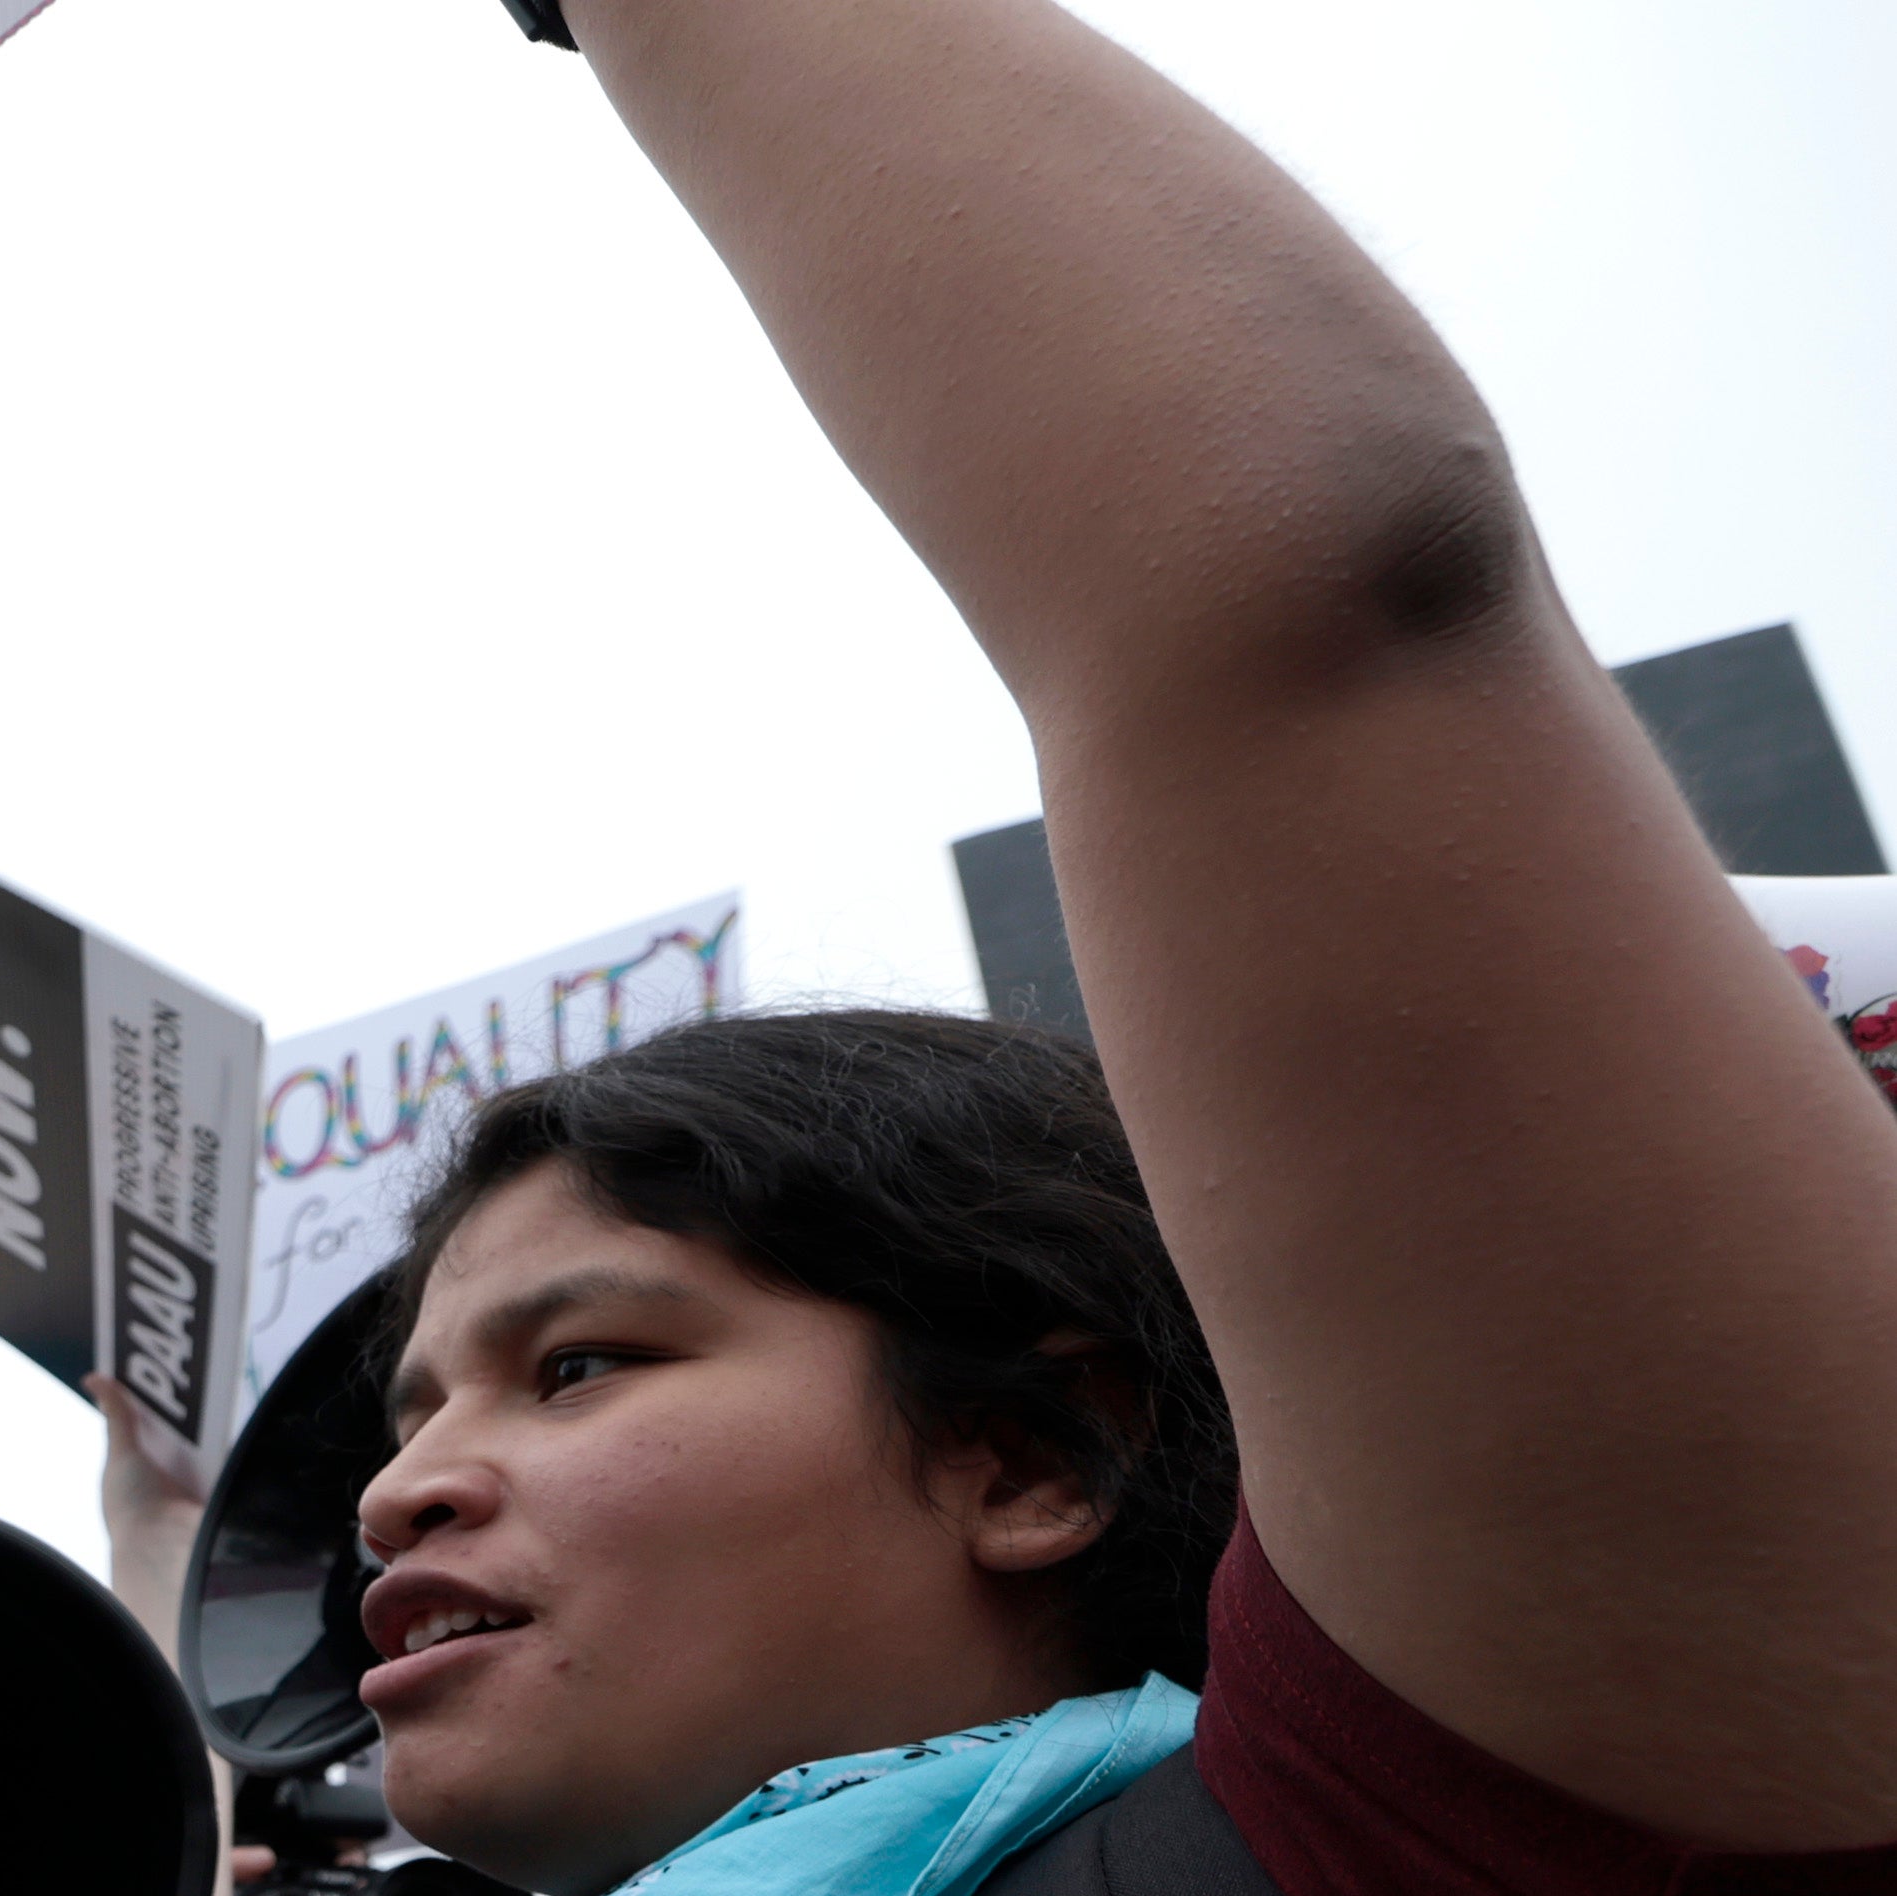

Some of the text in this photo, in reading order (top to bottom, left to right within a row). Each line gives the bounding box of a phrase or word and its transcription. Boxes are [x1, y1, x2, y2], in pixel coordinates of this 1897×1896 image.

[110, 1014, 143, 1203] PROGRESSIVE
[149, 998, 183, 1229] ANTI-ABORTION
[264, 908, 739, 1178] QUALITY
[189, 1122, 222, 1255] UPRISING
[125, 1230, 200, 1421] PAAU
